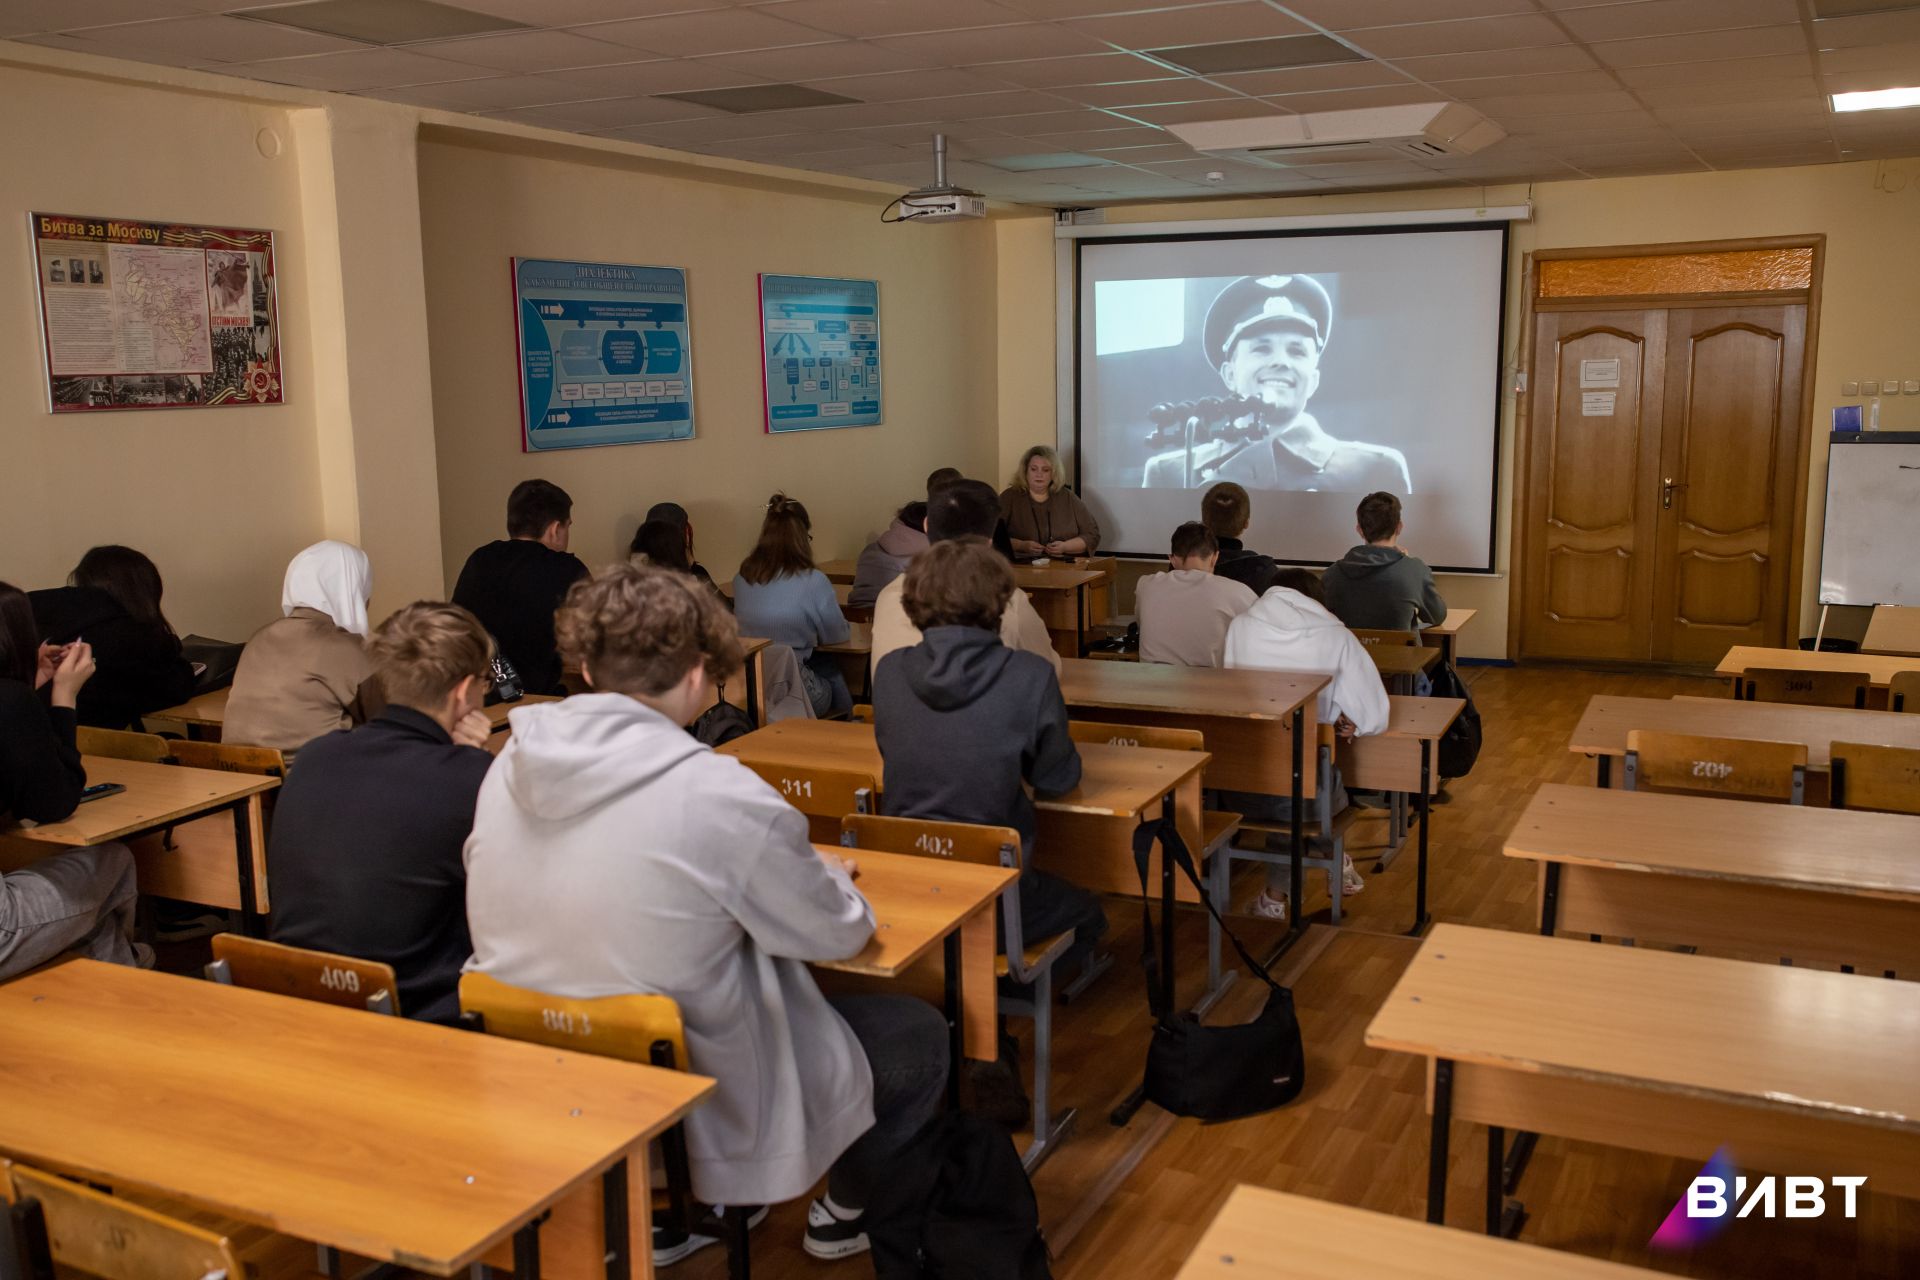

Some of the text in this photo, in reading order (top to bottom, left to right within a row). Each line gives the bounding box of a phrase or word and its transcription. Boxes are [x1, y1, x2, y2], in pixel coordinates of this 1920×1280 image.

[41, 217, 160, 243] Битва за Москву
[575, 266, 636, 280] ДИАЛЕКТИКА
[782, 778, 812, 798] 311
[916, 833, 954, 855] 402
[320, 965, 360, 993] 409
